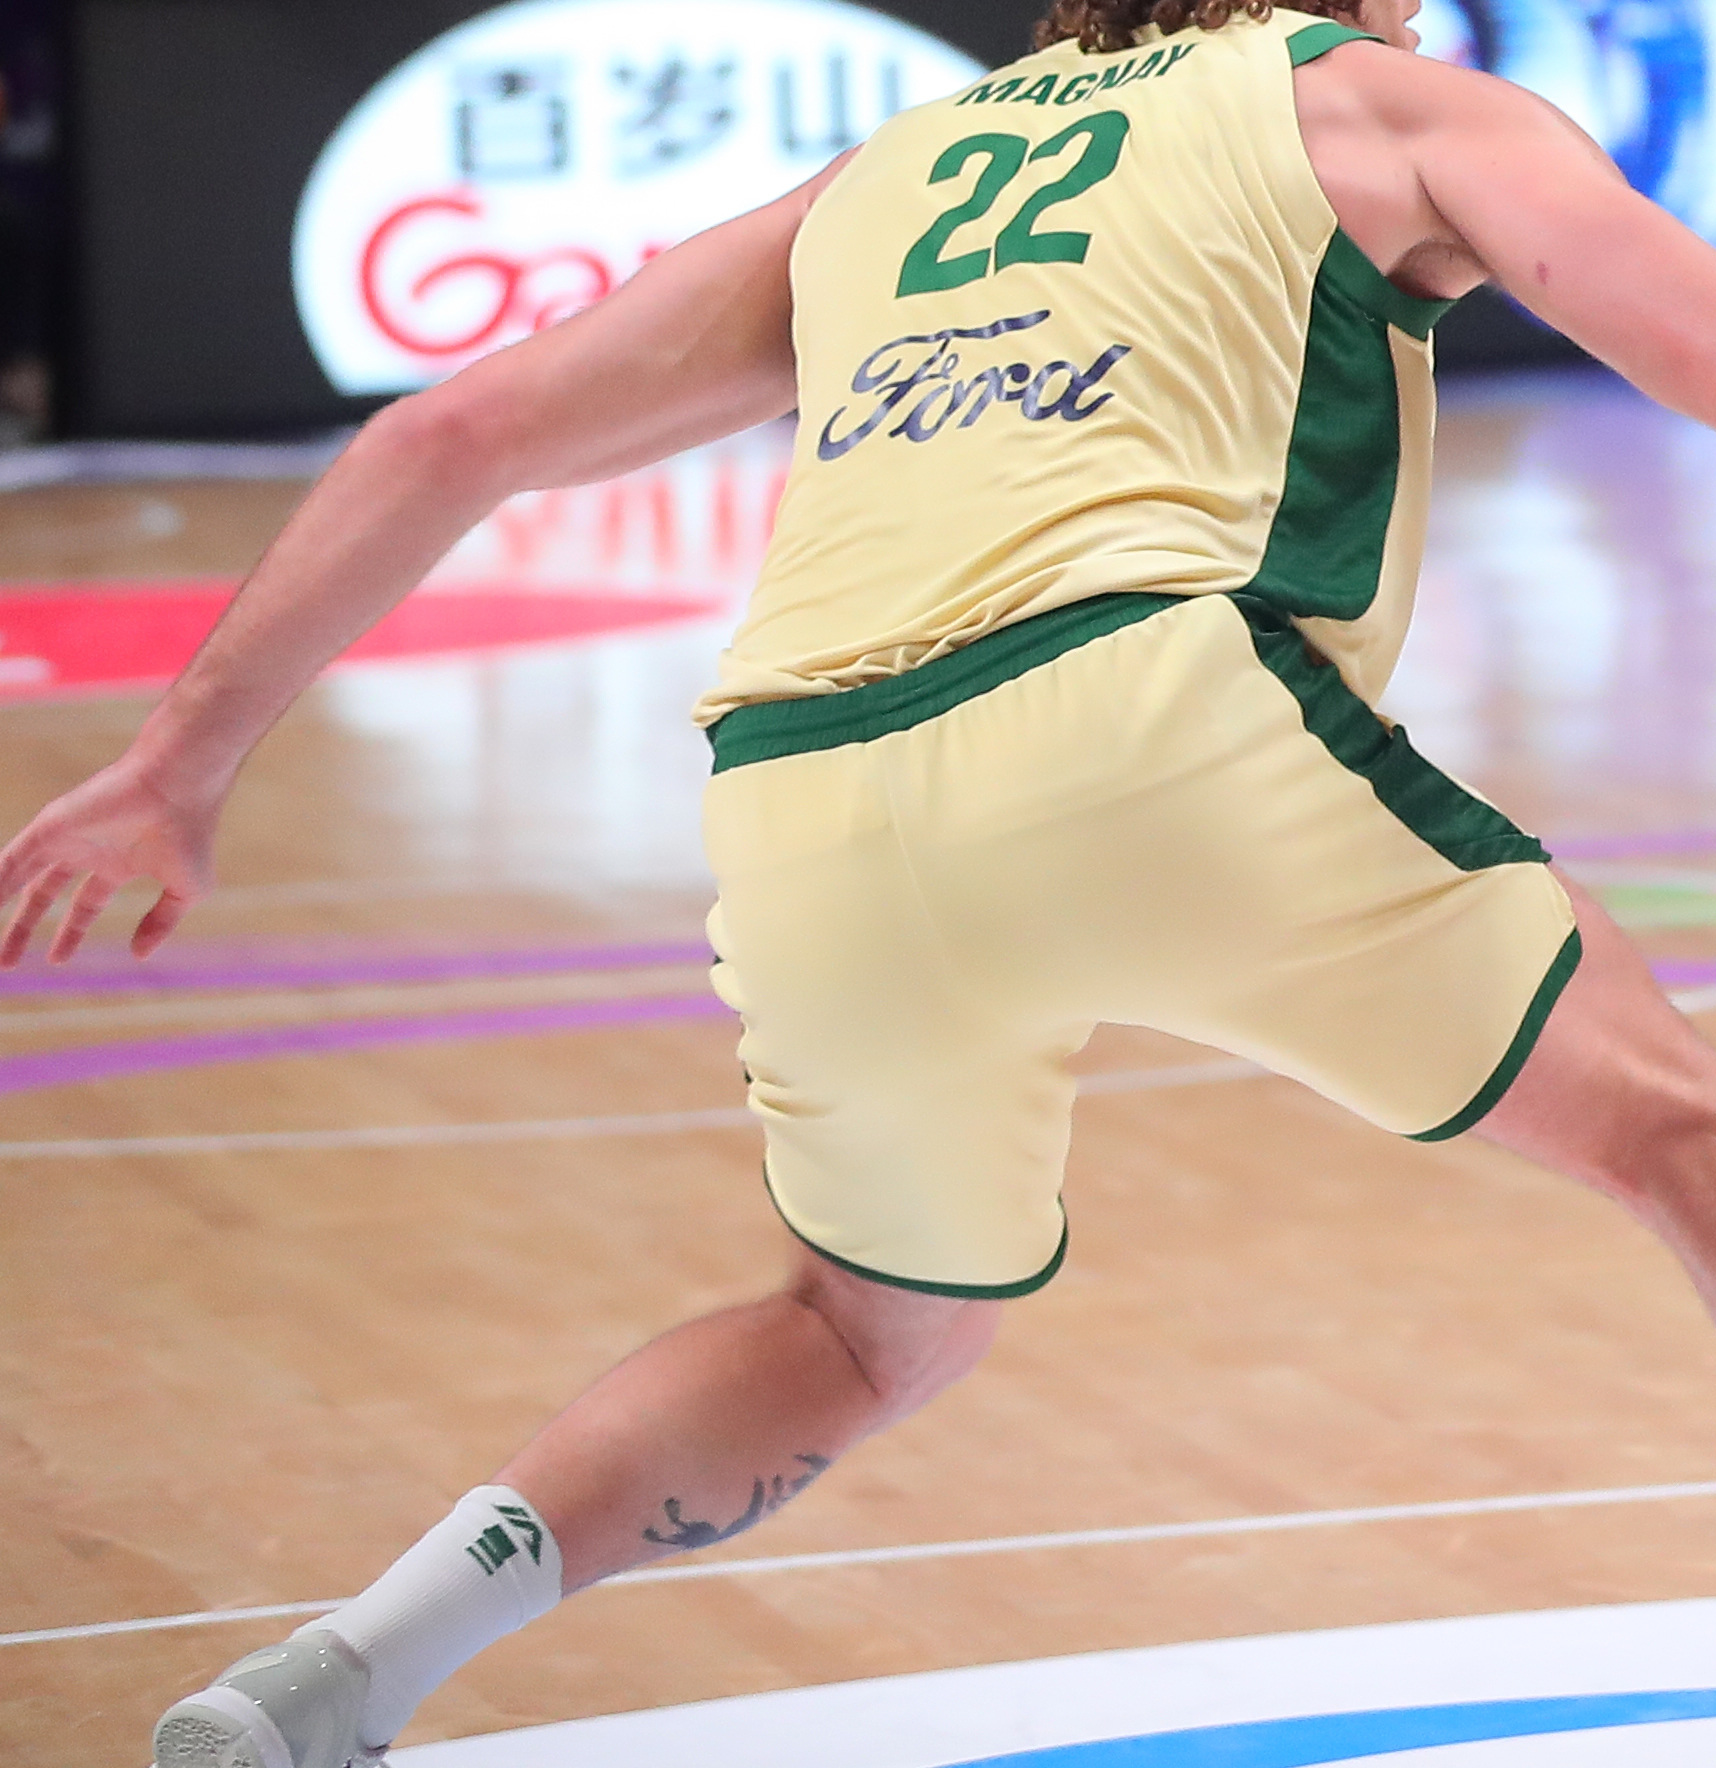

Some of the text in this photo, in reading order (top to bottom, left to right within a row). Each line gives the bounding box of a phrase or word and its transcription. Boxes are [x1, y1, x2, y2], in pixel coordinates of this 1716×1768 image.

[955, 43, 1199, 107] MAGNAY
[894, 110, 1130, 299] 22
[817, 309, 1132, 461] Ford
